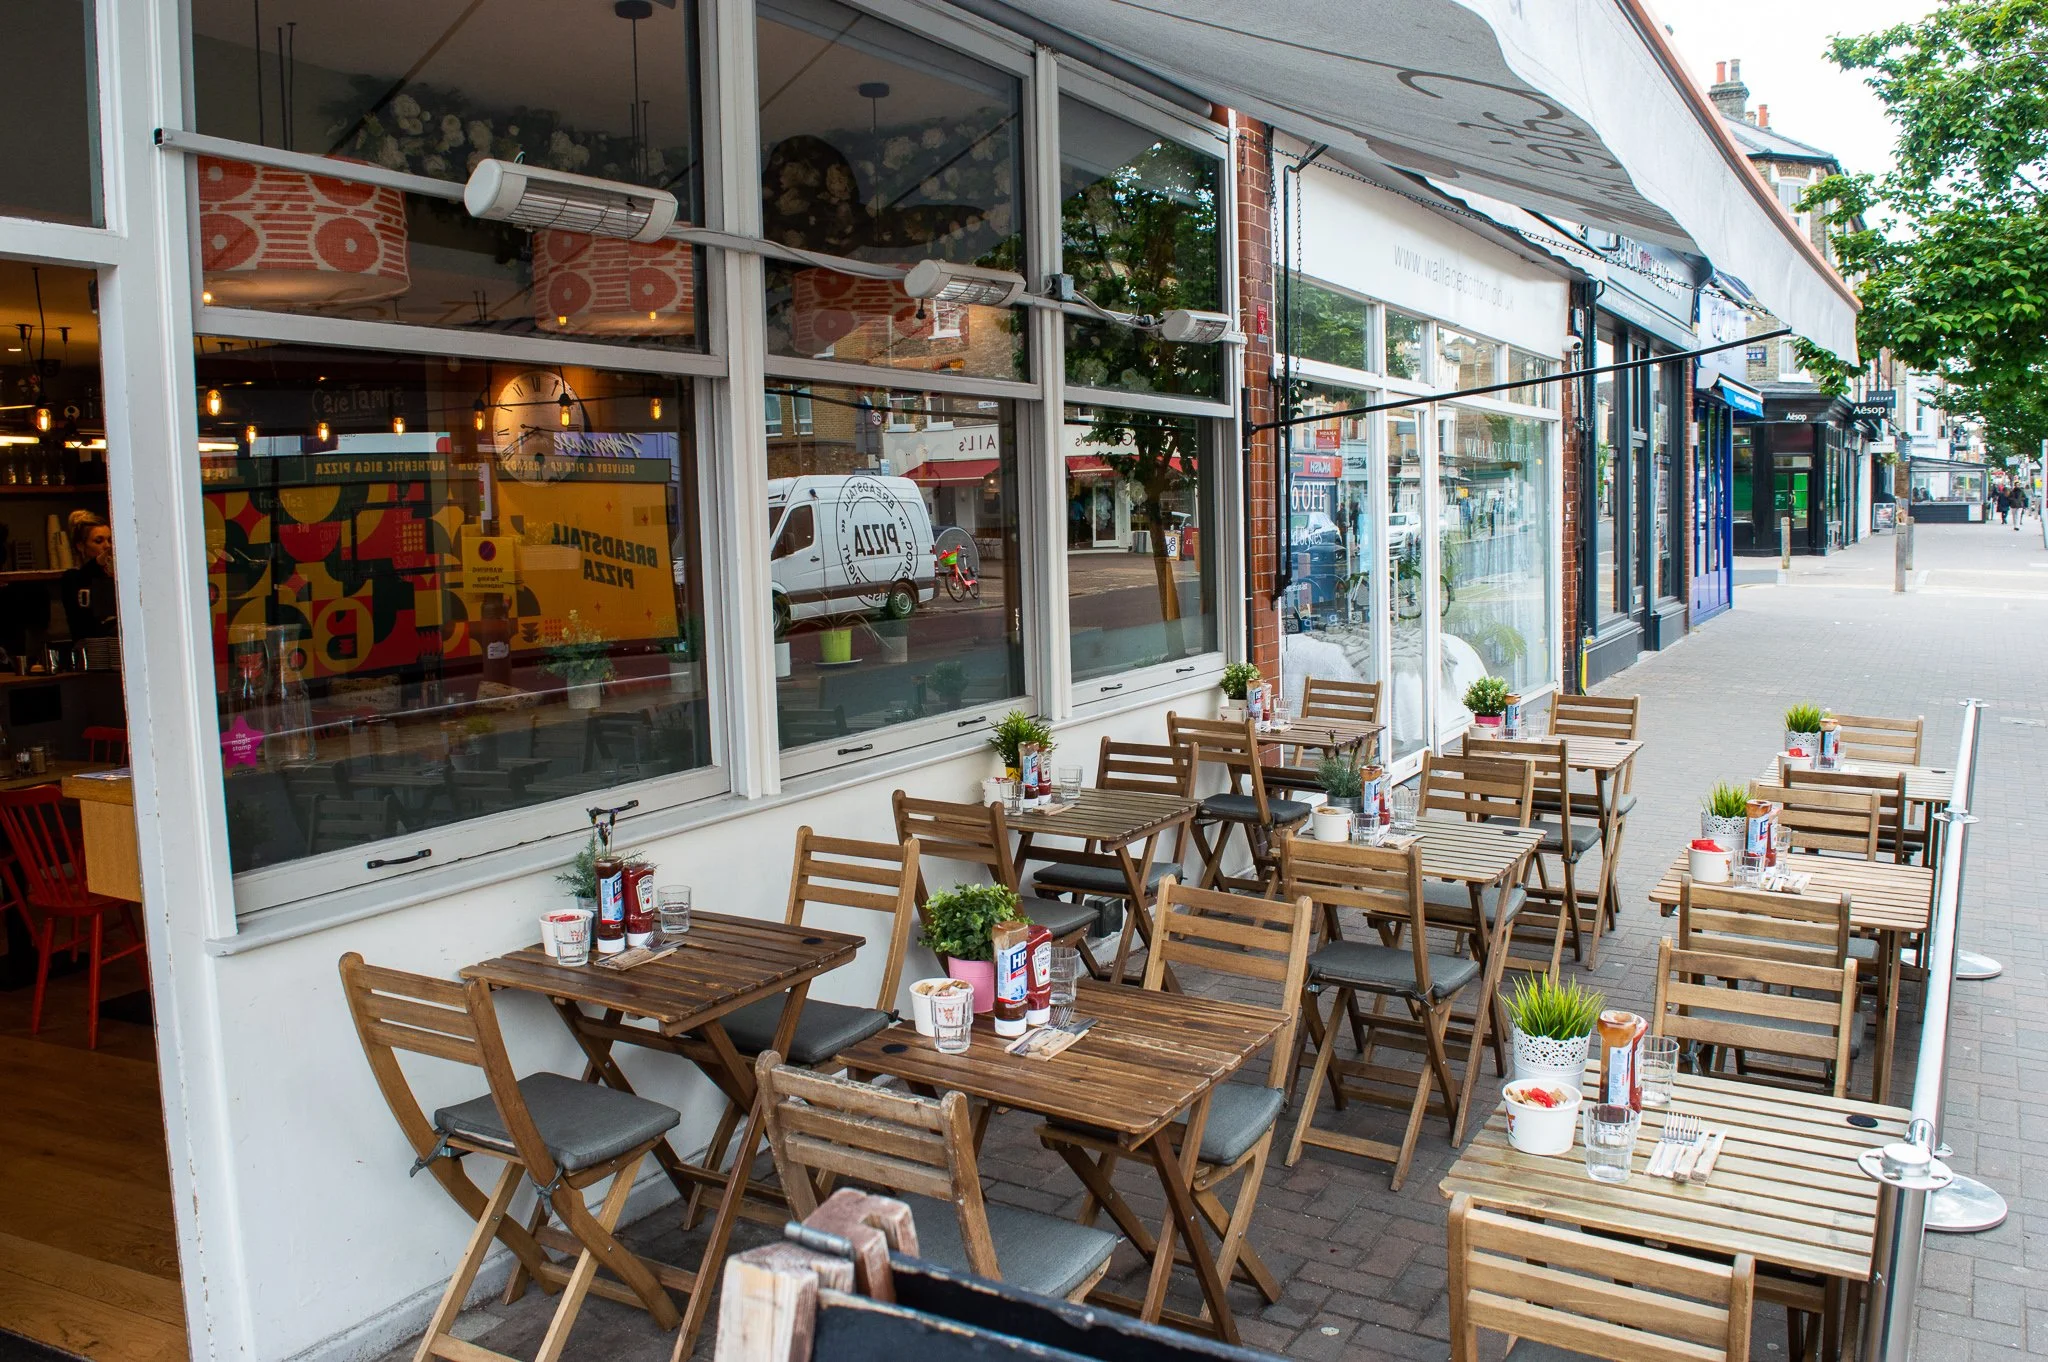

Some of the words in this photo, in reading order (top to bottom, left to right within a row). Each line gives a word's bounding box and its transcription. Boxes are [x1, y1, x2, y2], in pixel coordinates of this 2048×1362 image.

[1465, 438, 1502, 460] WALLACE
[1301, 481, 1327, 510] OFF
[231, 737, 251, 746] magic
[232, 744, 252, 752] stamp
[1012, 950, 1027, 969] HP
